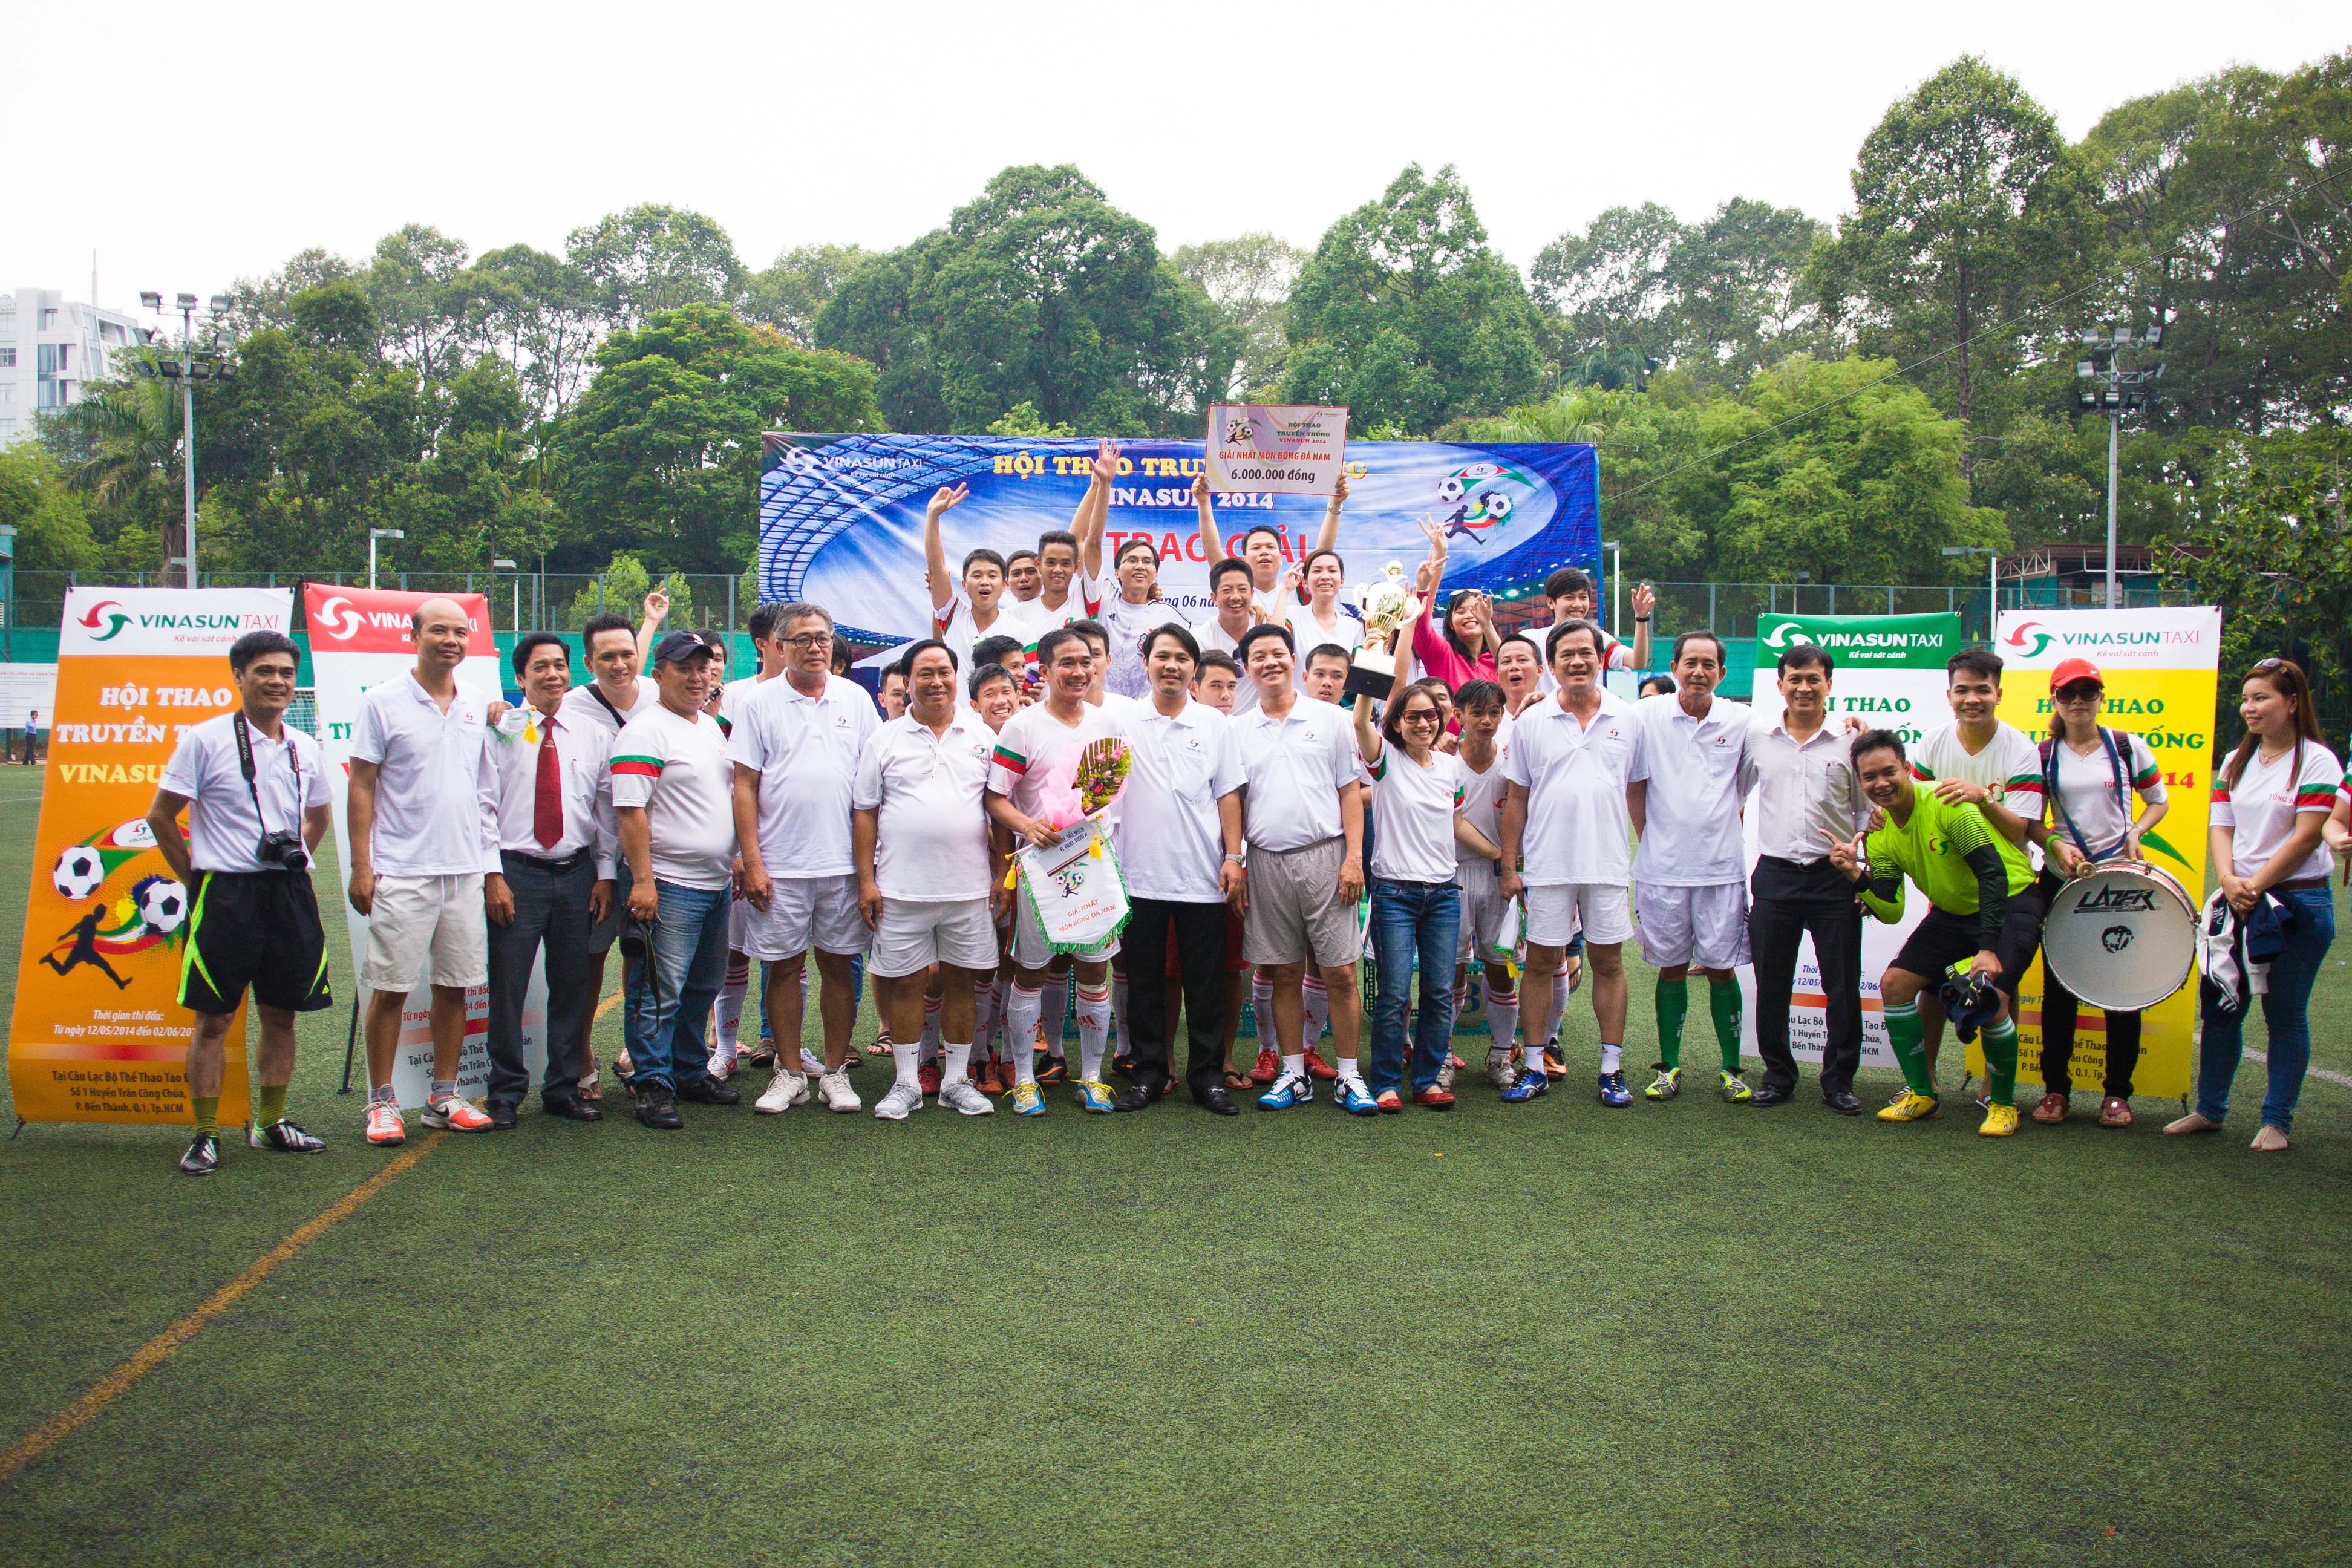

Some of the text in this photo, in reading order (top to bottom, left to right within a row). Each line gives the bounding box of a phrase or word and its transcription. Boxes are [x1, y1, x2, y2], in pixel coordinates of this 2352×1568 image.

[823, 456, 923, 469] VINASUN TAXI
[1219, 449, 1330, 461] GIẢI NHẤT MÔN BÓNG ĐÁ NAM
[993, 451, 1206, 480] HỘI THO TRU
[1231, 468, 1315, 484] 6.000.000 đồng
[1109, 488, 1275, 509] INASU 2014
[1181, 595, 1197, 607] 06
[139, 614, 279, 629] VINASUN TAXI
[367, 612, 414, 629] VINA
[1816, 633, 1944, 647] VINASUN TAXI
[2062, 630, 2200, 645] VINASUN TAXI
[100, 682, 233, 711] HỘI THAO
[1843, 697, 1911, 713] THAO
[56, 715, 167, 743] TRUYỀN
[2138, 725, 2206, 749] ỐNG
[59, 763, 167, 783] VINASU
[2164, 772, 2195, 789] 14
[1080, 898, 1099, 911] NHẤT
[2076, 883, 2156, 911] LAZER
[1059, 923, 1073, 932] MÔN
[1101, 904, 1116, 914] NAM
[1798, 978, 1822, 987] 12/05/
[467, 986, 477, 996] thi
[93, 1010, 111, 1020] Thời
[112, 1010, 131, 1022] gian
[132, 1011, 145, 1021] thi
[403, 1011, 413, 1022] Từ
[474, 1000, 487, 1010] đến
[1798, 1015, 1811, 1027] Lạc
[1813, 1017, 1823, 1028] Bộ
[1864, 1021, 1879, 1030] Tao
[65, 1025, 87, 1037] ngày
[87, 1025, 135, 1036] 12/05/2014
[136, 1025, 152, 1036] đến
[153, 1027, 195, 1037] 02/06/20
[1792, 1040, 1806, 1050] Bến
[1808, 1042, 1826, 1051] Thàn
[408, 1056, 422, 1068] Tại
[468, 1042, 484, 1054] Thể
[2083, 1054, 2104, 1066] Công
[2022, 1062, 2028, 1071] P.
[88, 1071, 103, 1084] Lạc
[105, 1071, 118, 1085] Bộ
[139, 1072, 163, 1083] Thao
[165, 1072, 182, 1083] Tao
[139, 1088, 160, 1100] Công
